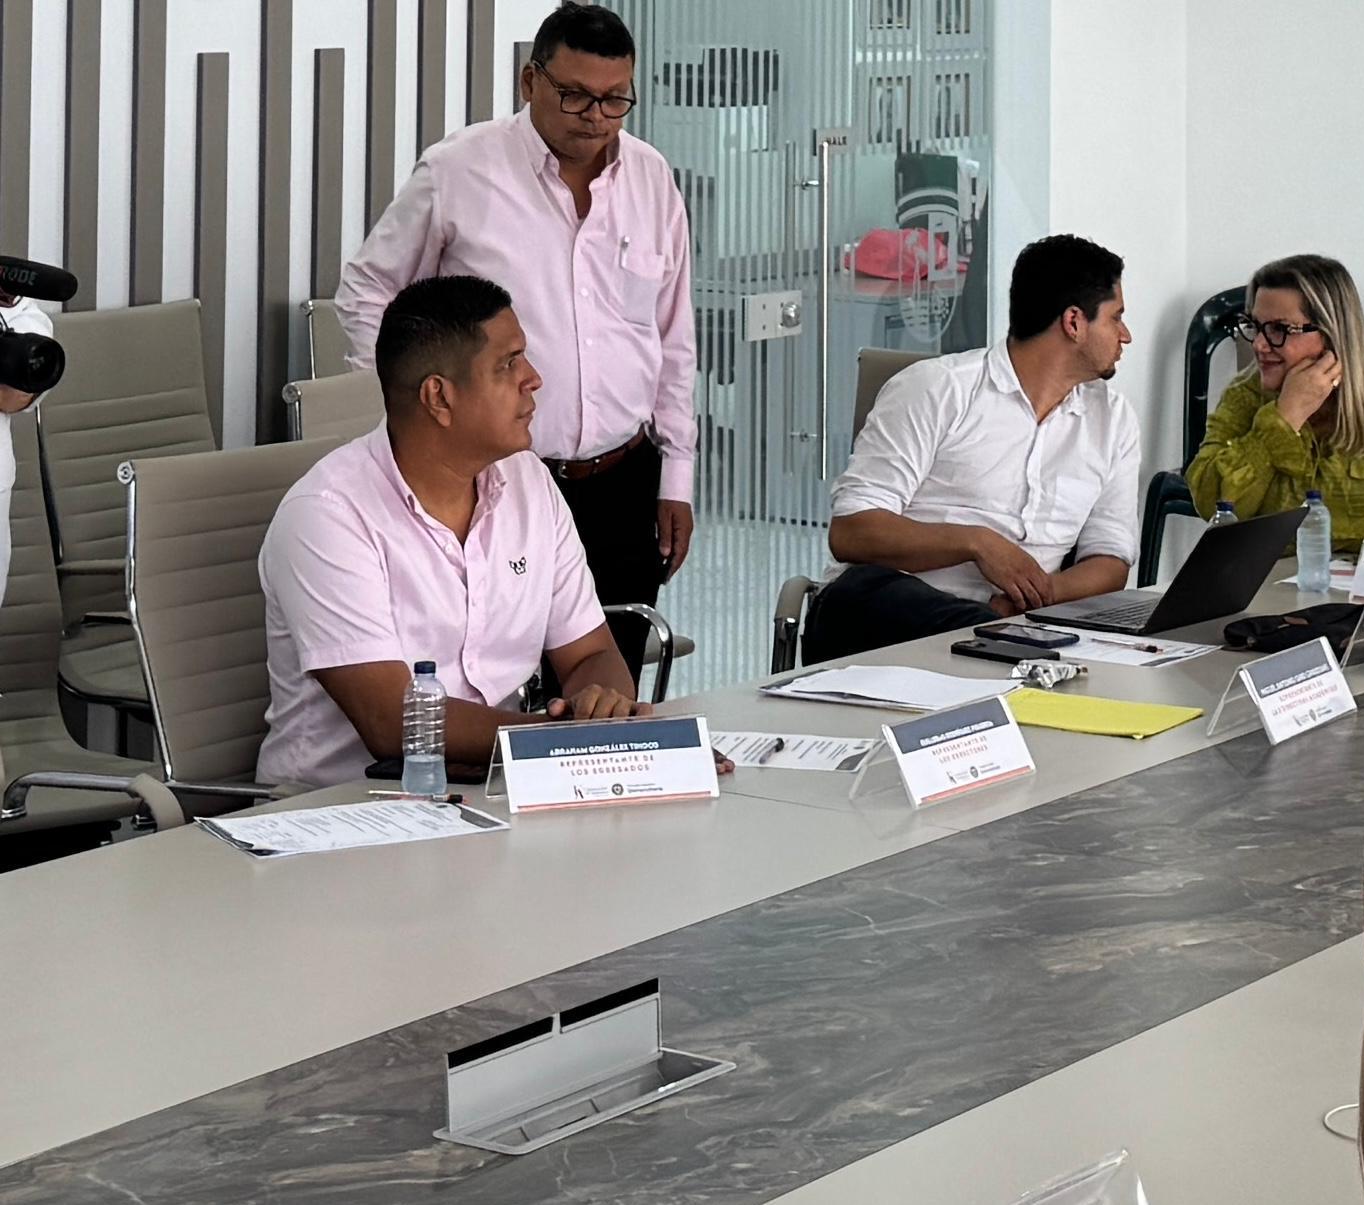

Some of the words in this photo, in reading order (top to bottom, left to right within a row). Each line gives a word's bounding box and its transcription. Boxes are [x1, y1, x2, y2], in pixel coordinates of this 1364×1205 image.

[560, 755, 639, 767] REPRESENTANTE
[643, 754, 654, 762] DE
[571, 768, 588, 776] LOS
[593, 764, 650, 774] EGRESADOS
